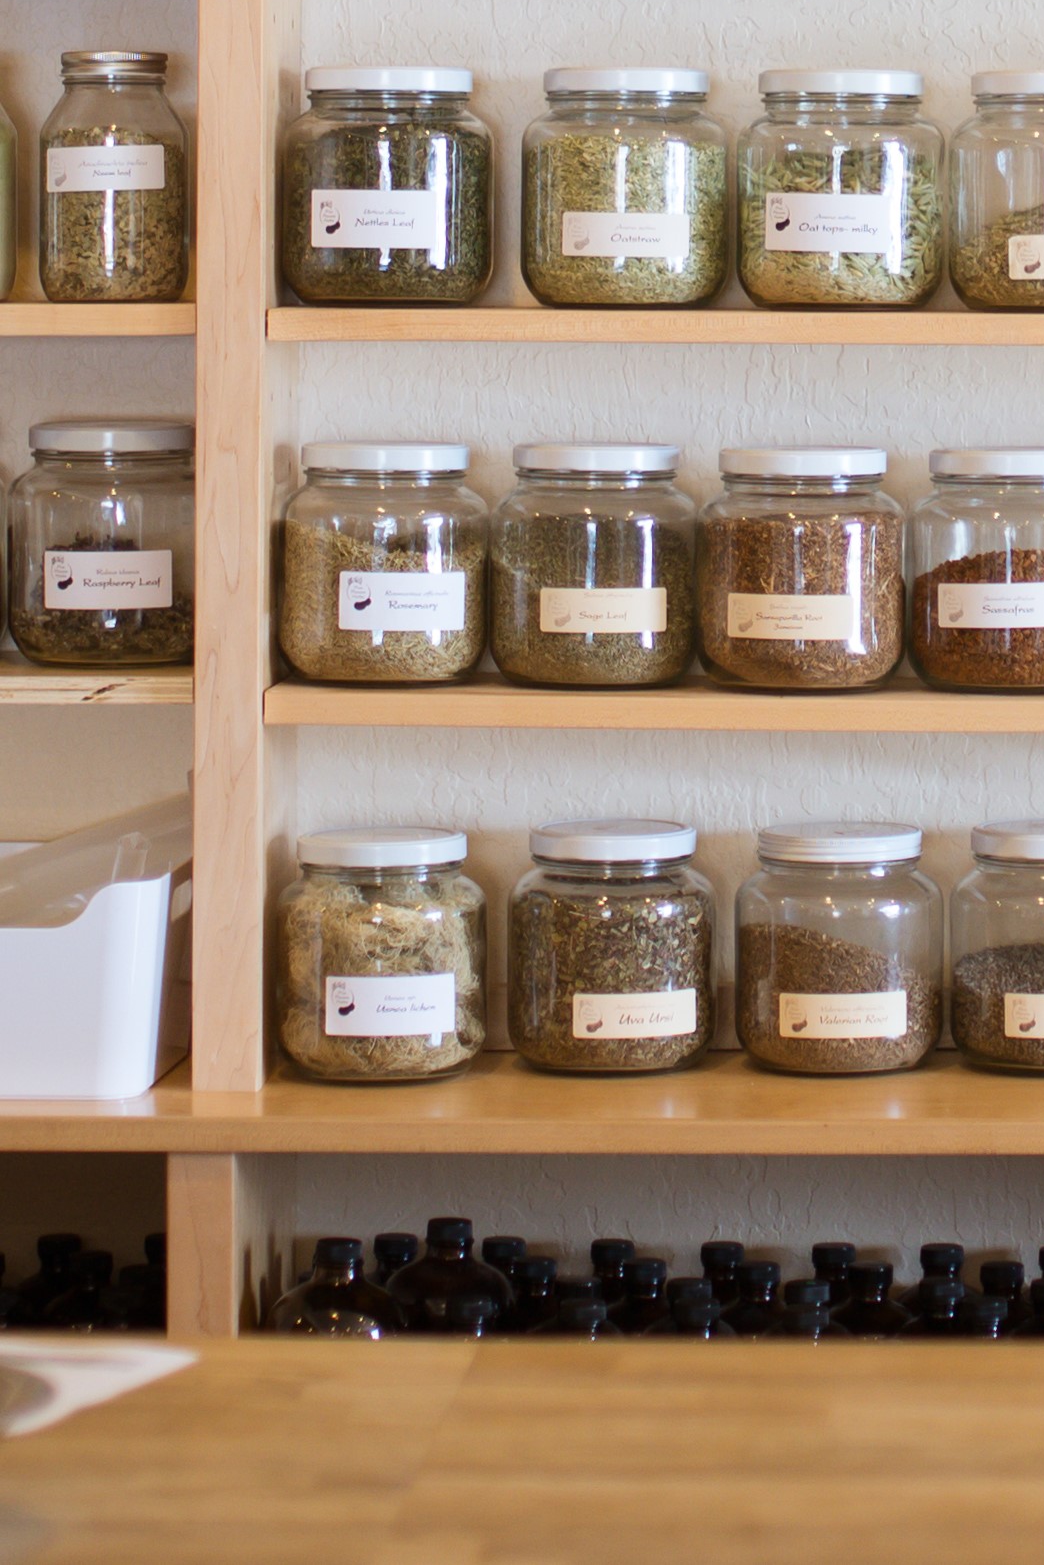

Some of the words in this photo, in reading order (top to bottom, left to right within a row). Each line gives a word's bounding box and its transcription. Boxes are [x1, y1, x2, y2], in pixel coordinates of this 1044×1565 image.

[392, 217, 415, 229] Leaf
[798, 222, 819, 232] Oat
[851, 223, 878, 235] milky
[83, 578, 136, 589] Raspberry
[139, 577, 162, 589] Leaf
[388, 600, 439, 611] Rosemary
[981, 604, 1036, 616] Sassafras
[579, 611, 604, 622] Sage
[606, 611, 628, 622] Leaf
[619, 1013, 645, 1025] Uva
